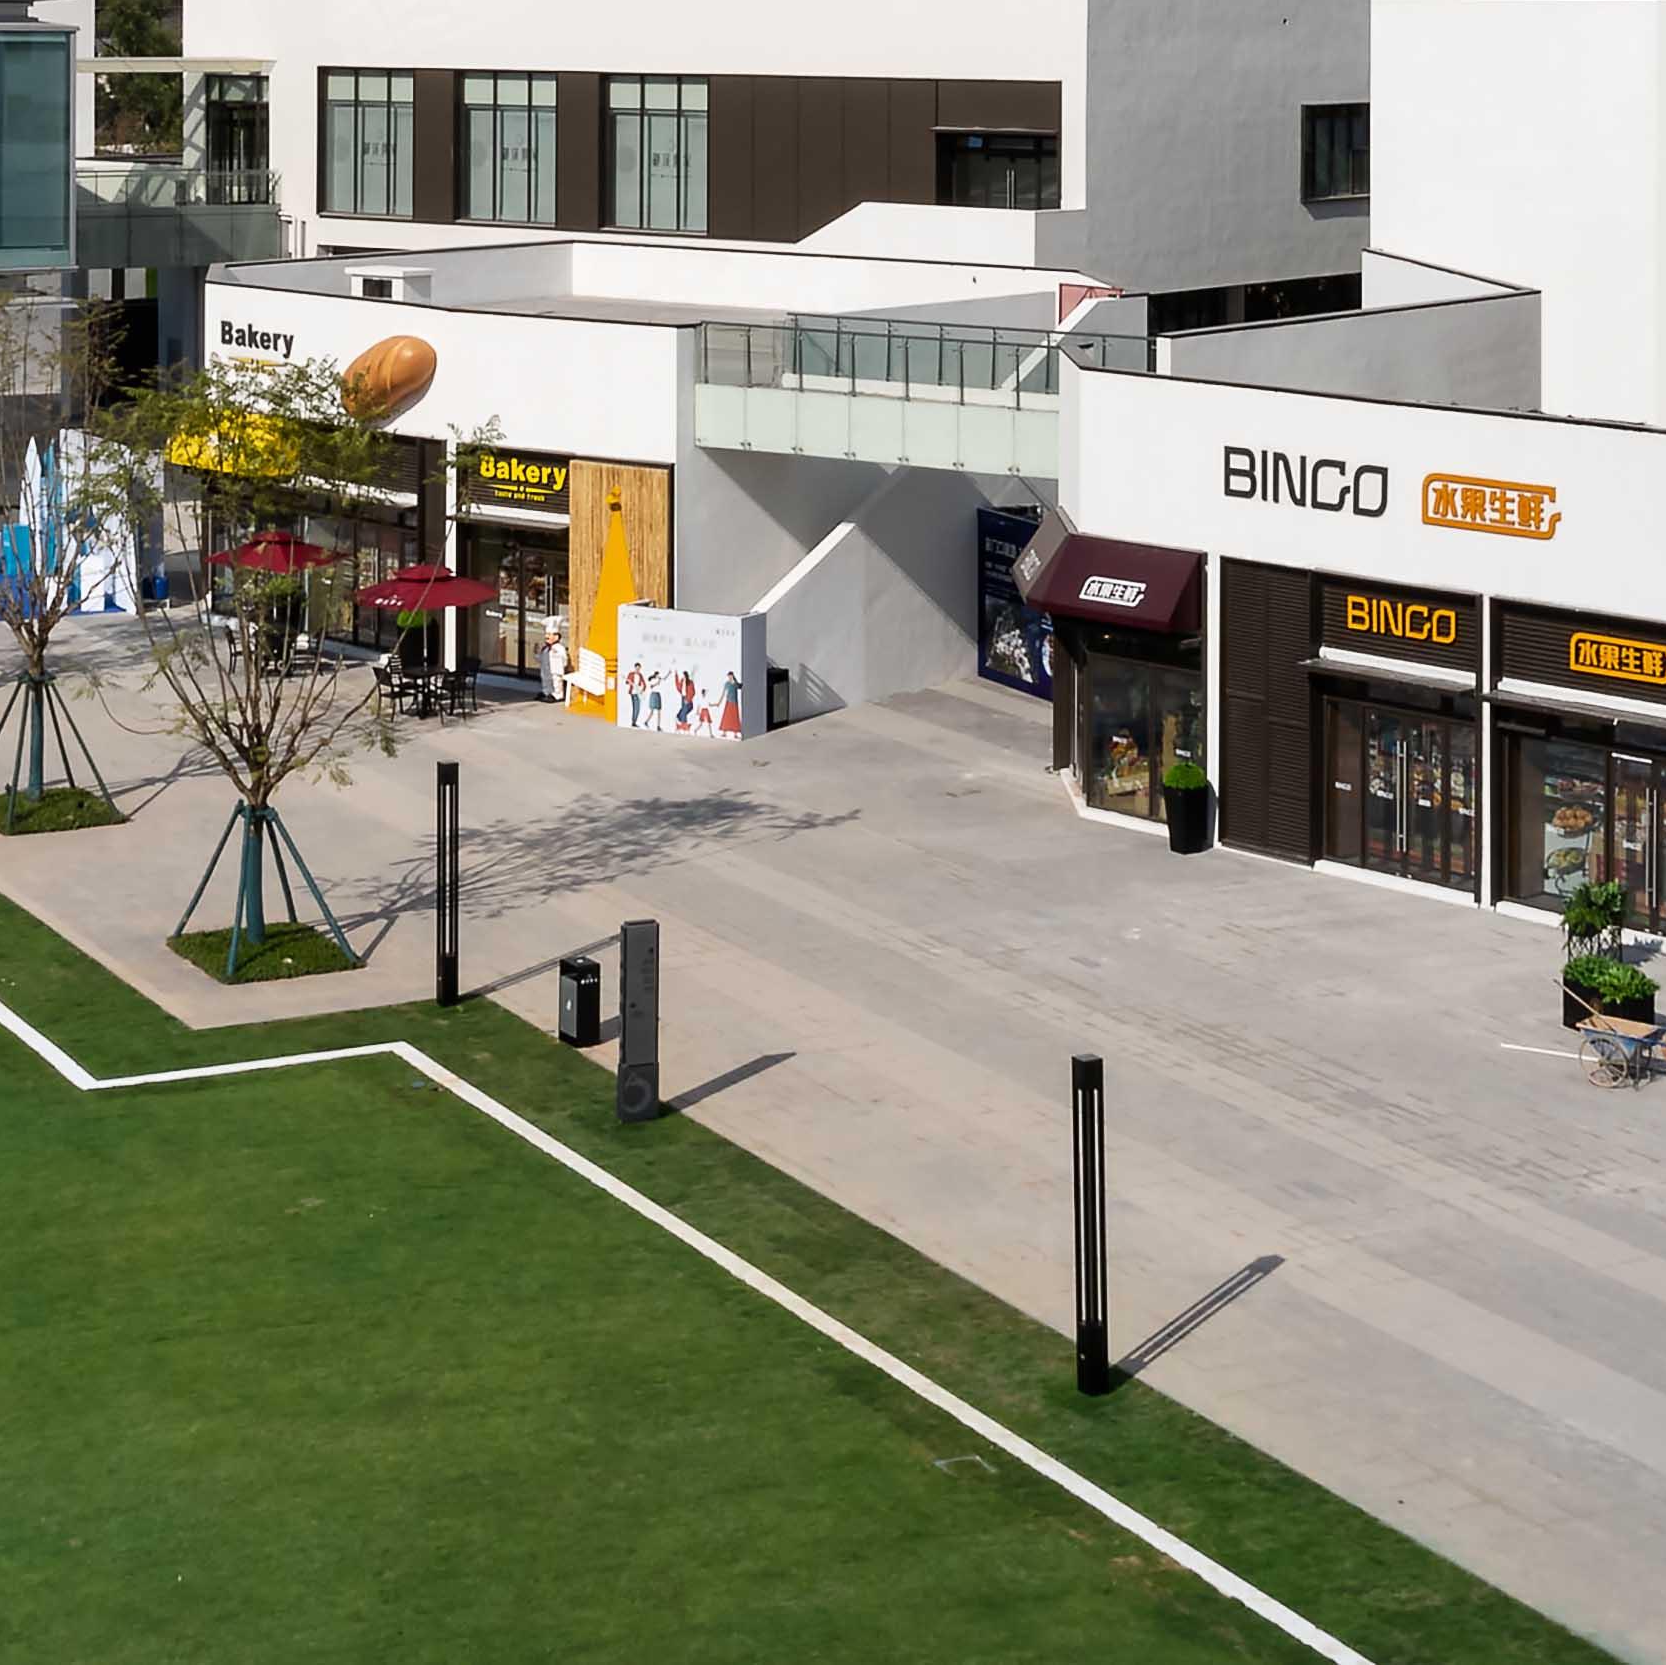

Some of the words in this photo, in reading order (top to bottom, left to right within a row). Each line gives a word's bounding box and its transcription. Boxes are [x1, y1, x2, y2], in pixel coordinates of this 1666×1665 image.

[220, 320, 294, 359] Bakery
[480, 453, 566, 491] Bakery
[1223, 445, 1389, 518] BINGO
[1431, 482, 1546, 531] 水果生鲜
[1345, 594, 1457, 645] BINGO
[1577, 640, 1665, 677] 水果生鲜
